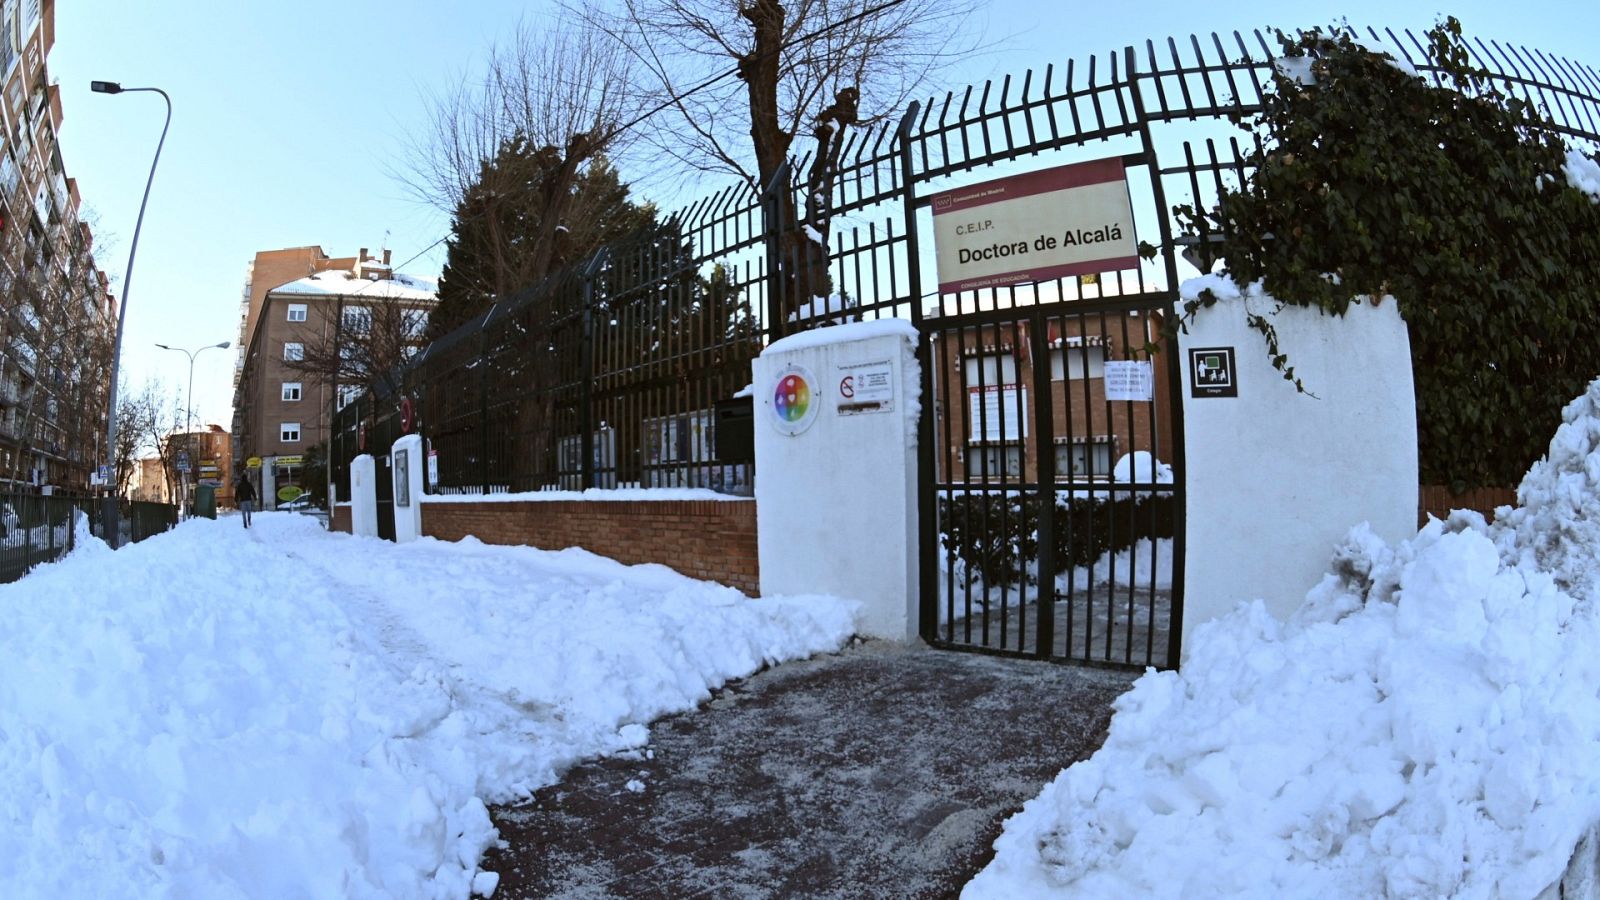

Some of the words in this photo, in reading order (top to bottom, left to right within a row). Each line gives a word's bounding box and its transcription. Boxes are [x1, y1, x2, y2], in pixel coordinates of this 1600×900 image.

[987, 187, 1005, 196] Madrid
[955, 219, 995, 236] C.E.I.P.
[958, 239, 1029, 265] Doctora
[1034, 234, 1057, 251] de
[1063, 223, 1123, 248] Alcalá
